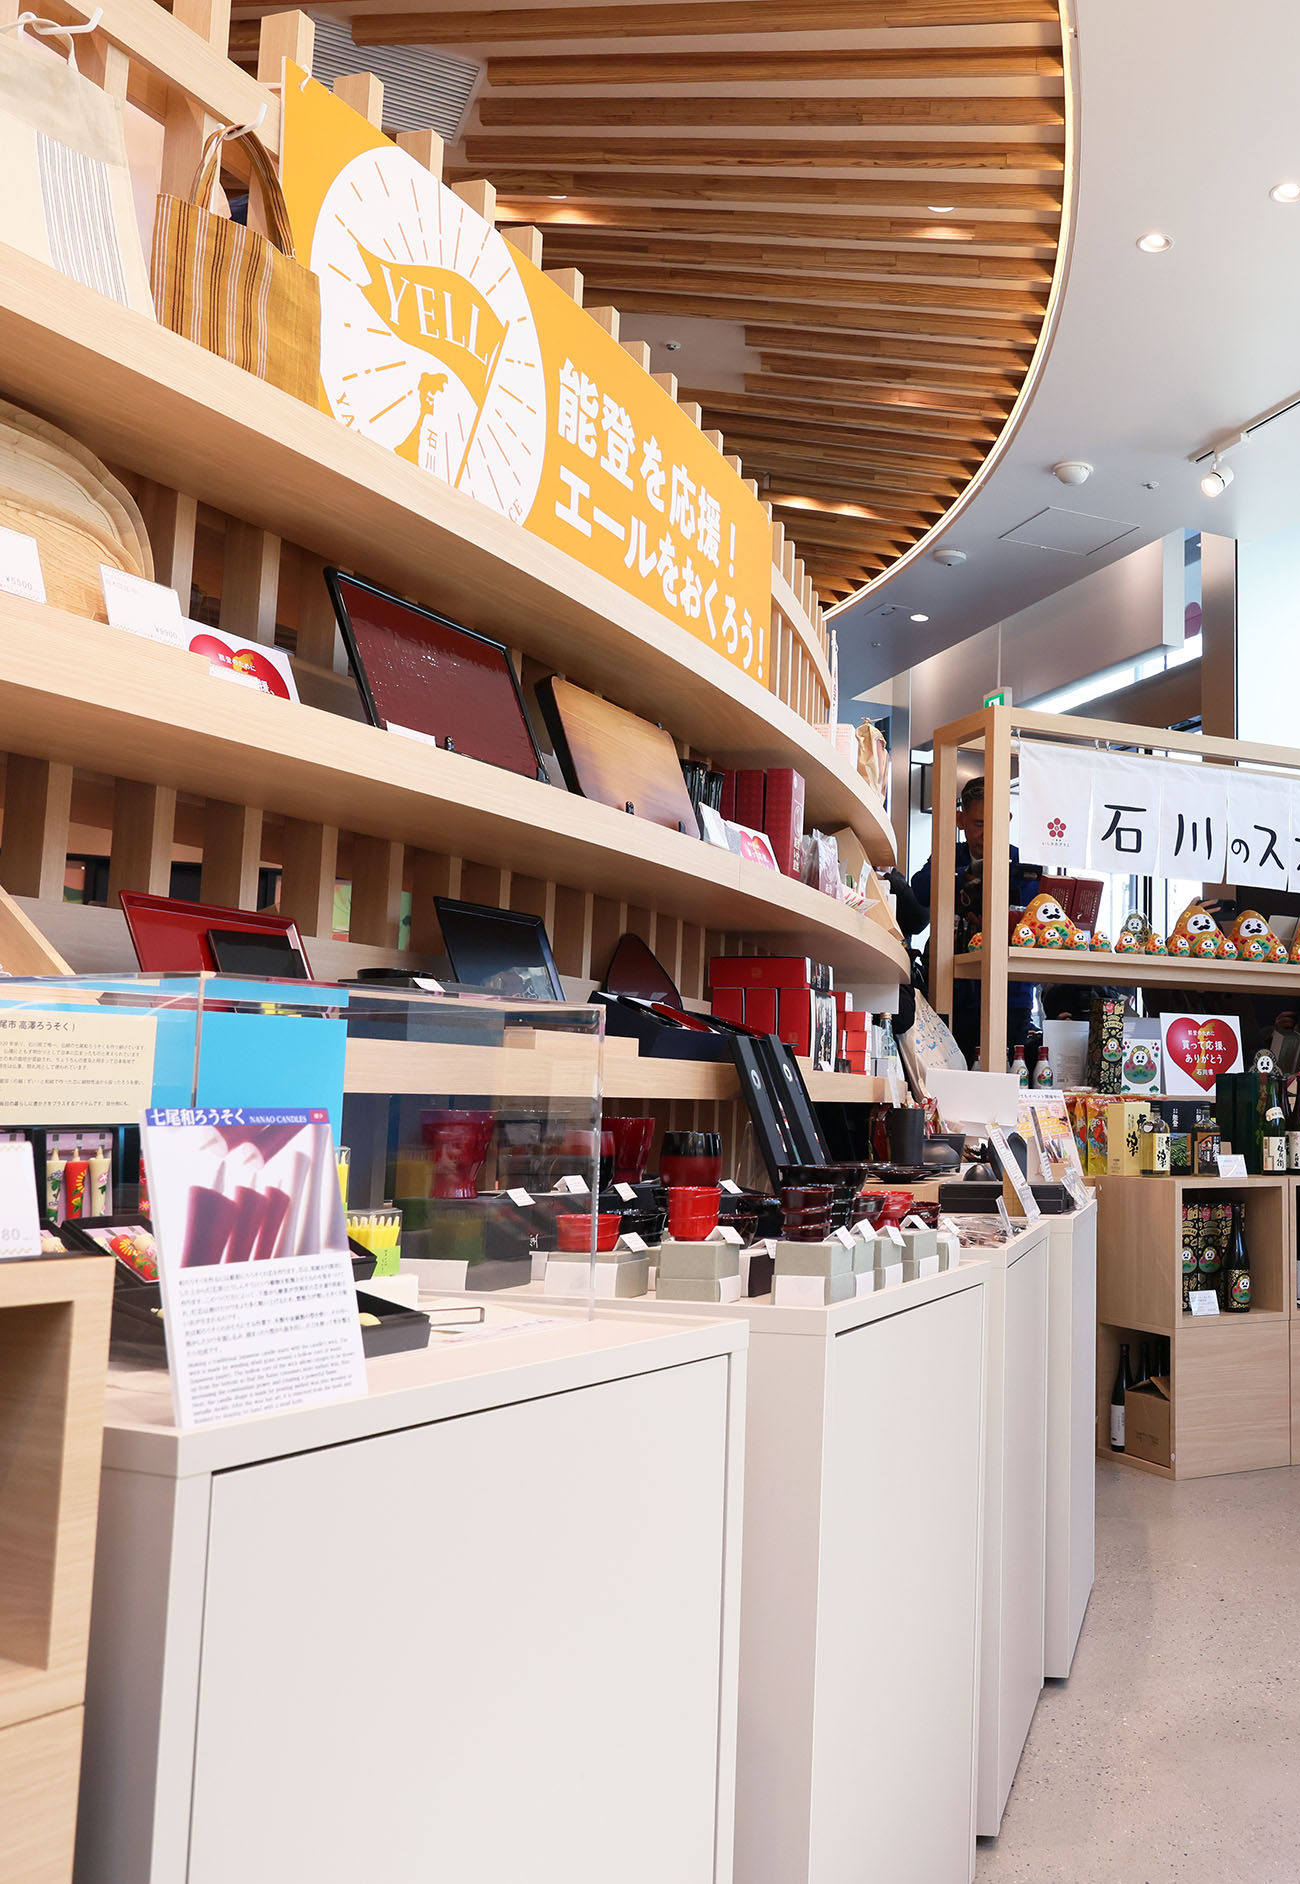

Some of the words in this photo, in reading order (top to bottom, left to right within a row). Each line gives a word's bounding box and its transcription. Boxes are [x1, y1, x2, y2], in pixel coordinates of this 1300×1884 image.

[379, 263, 489, 365] YELL
[558, 357, 736, 578] 能登を応援！
[555, 464, 764, 679] エールをおくろう！
[1185, 1053, 1223, 1064] ありがとう
[150, 1108, 246, 1126] 七尾和ろうそく
[249, 1115, 275, 1124] NANAO
[276, 1115, 307, 1124] CANDLES
